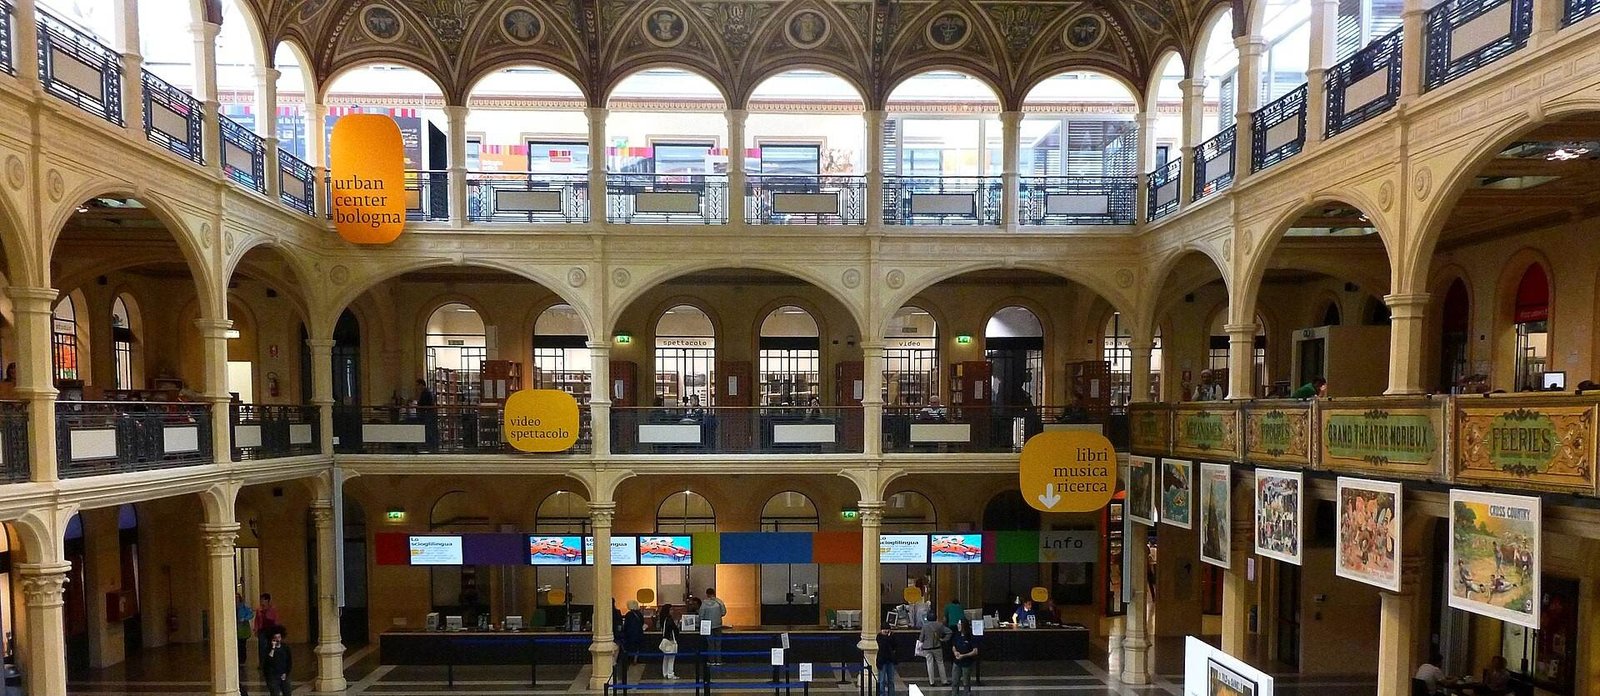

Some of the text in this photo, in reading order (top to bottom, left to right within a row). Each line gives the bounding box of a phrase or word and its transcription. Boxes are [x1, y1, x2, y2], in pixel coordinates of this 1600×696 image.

[335, 174, 384, 190] urban
[335, 195, 387, 207] center
[335, 208, 402, 228] bologna
[510, 416, 541, 426] video
[510, 428, 569, 441] spettacolo
[1327, 423, 1353, 443] GRAND
[1390, 424, 1428, 448] MORIEUX
[1077, 448, 1108, 461] libri
[1053, 464, 1108, 477] musica
[1056, 479, 1108, 493] ricerca
[1043, 536, 1083, 549] info
